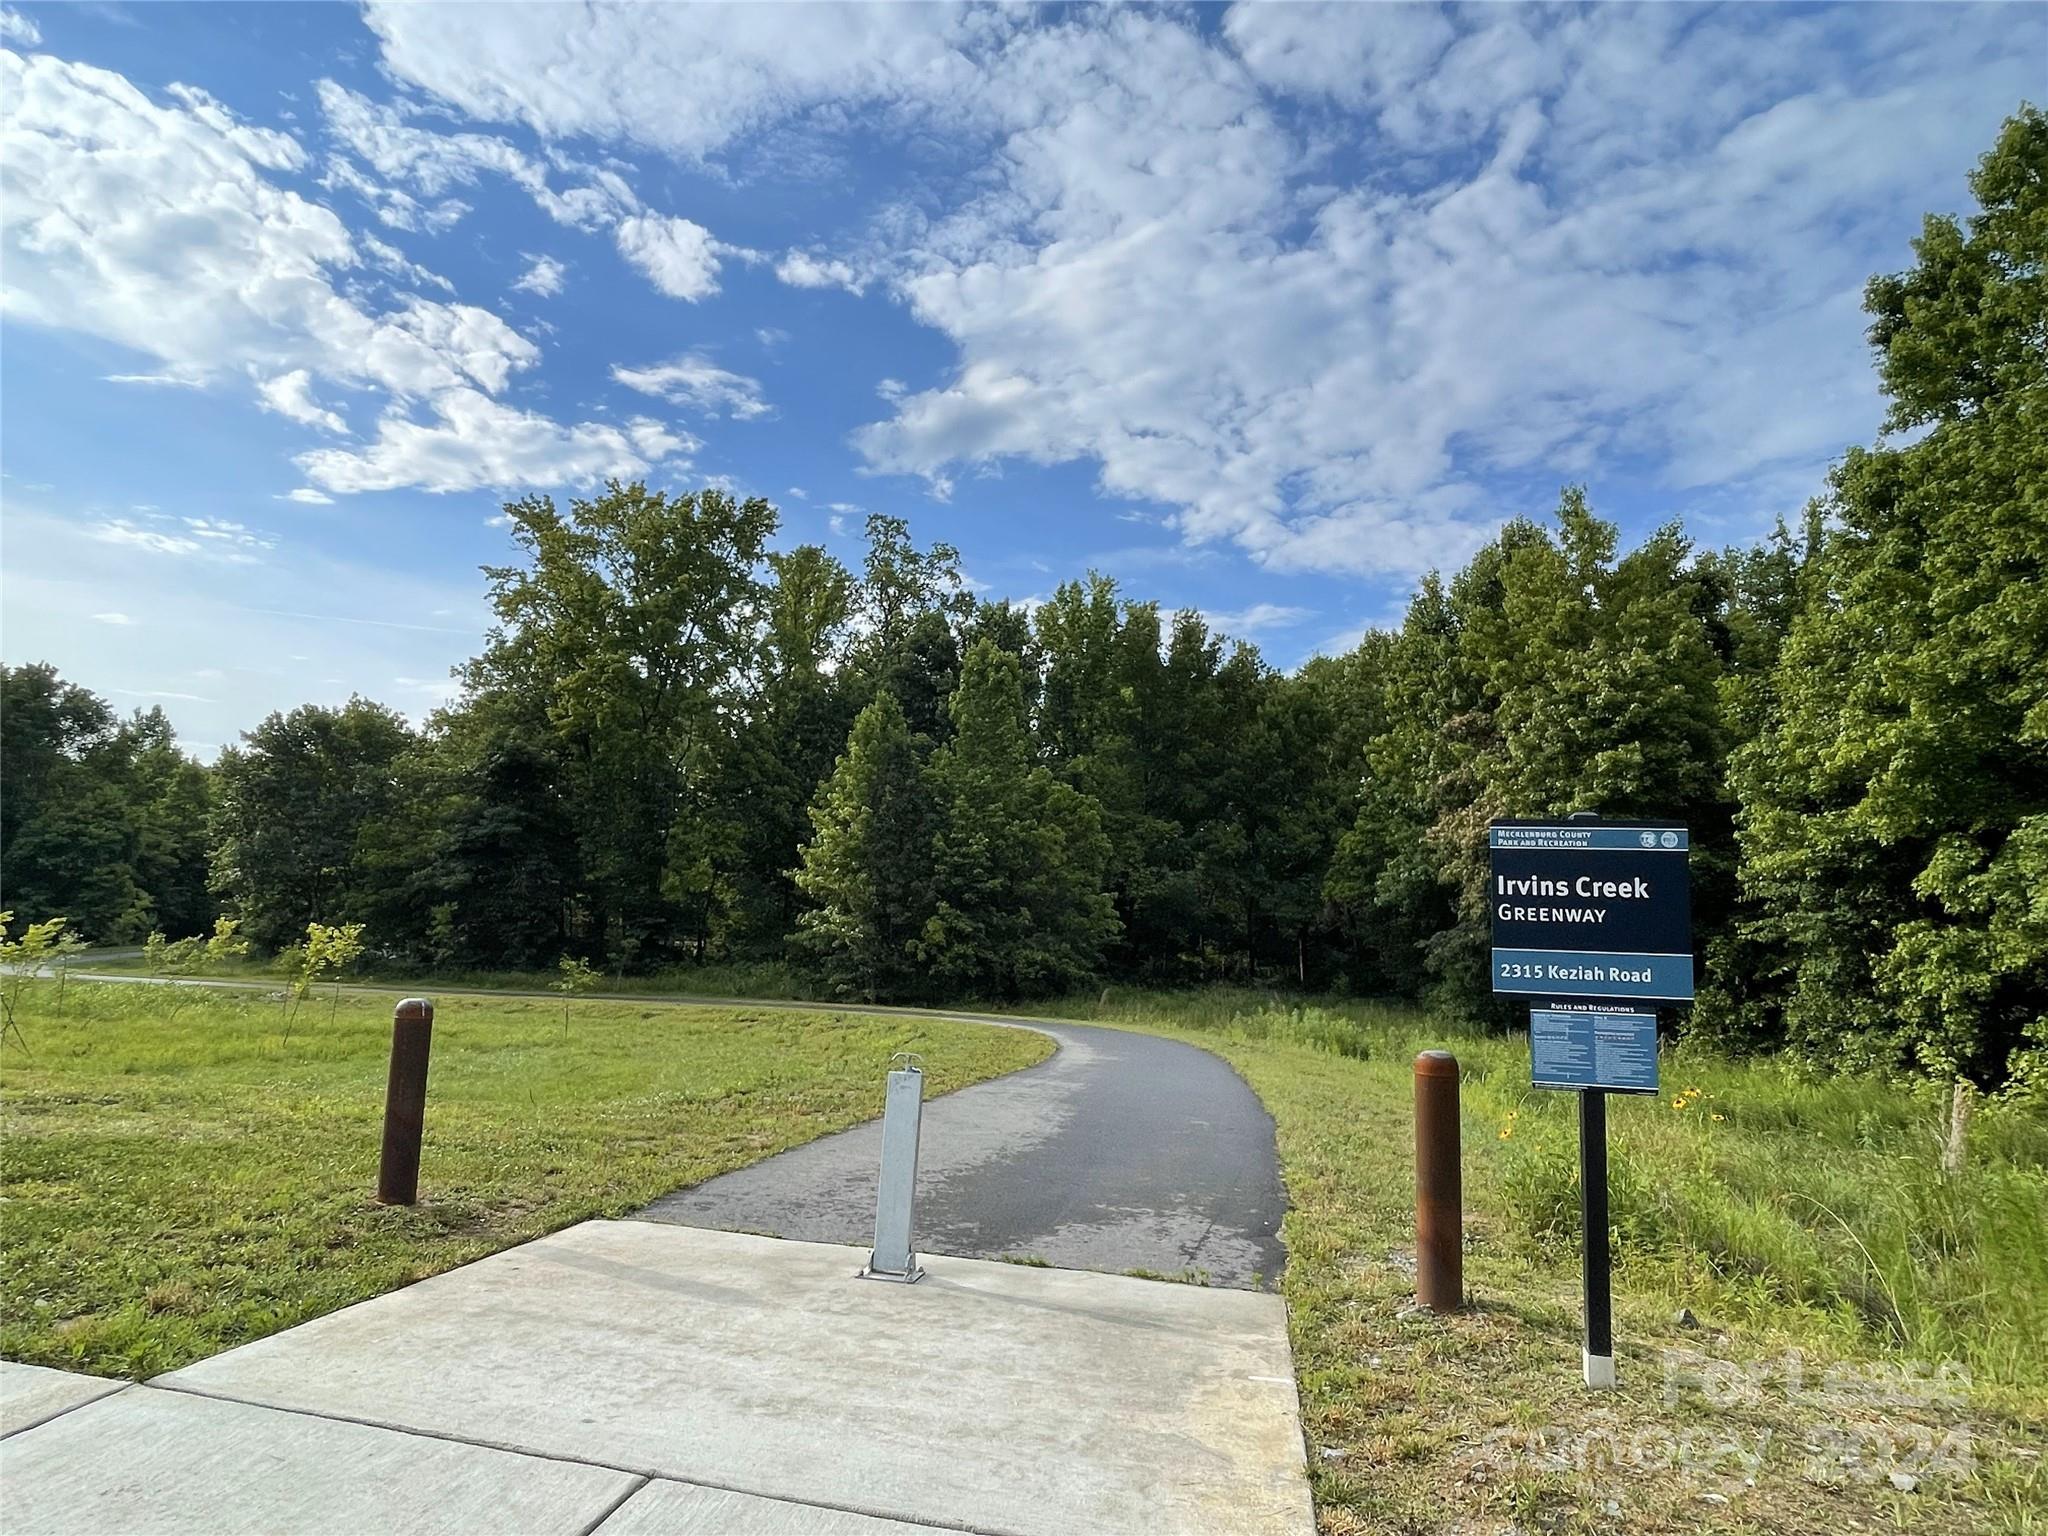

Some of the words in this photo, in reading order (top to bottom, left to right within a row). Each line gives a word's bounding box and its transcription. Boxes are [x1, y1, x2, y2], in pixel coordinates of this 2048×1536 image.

[1498, 830, 1557, 839] MECKLENBURG
[1559, 830, 1592, 839] COUNTY
[1498, 839, 1519, 847] PARK
[1520, 839, 1536, 847] AND
[1537, 839, 1588, 847] RECREATION
[1498, 875, 1569, 897] Irvins
[1575, 876, 1650, 899] Creek
[1498, 903, 1607, 923] GREENWAY
[1501, 964, 1543, 979] 2315
[1548, 965, 1604, 981] Keziah
[1610, 967, 1652, 983] Road
[1588, 1004, 1635, 1013] REGULATIONS
